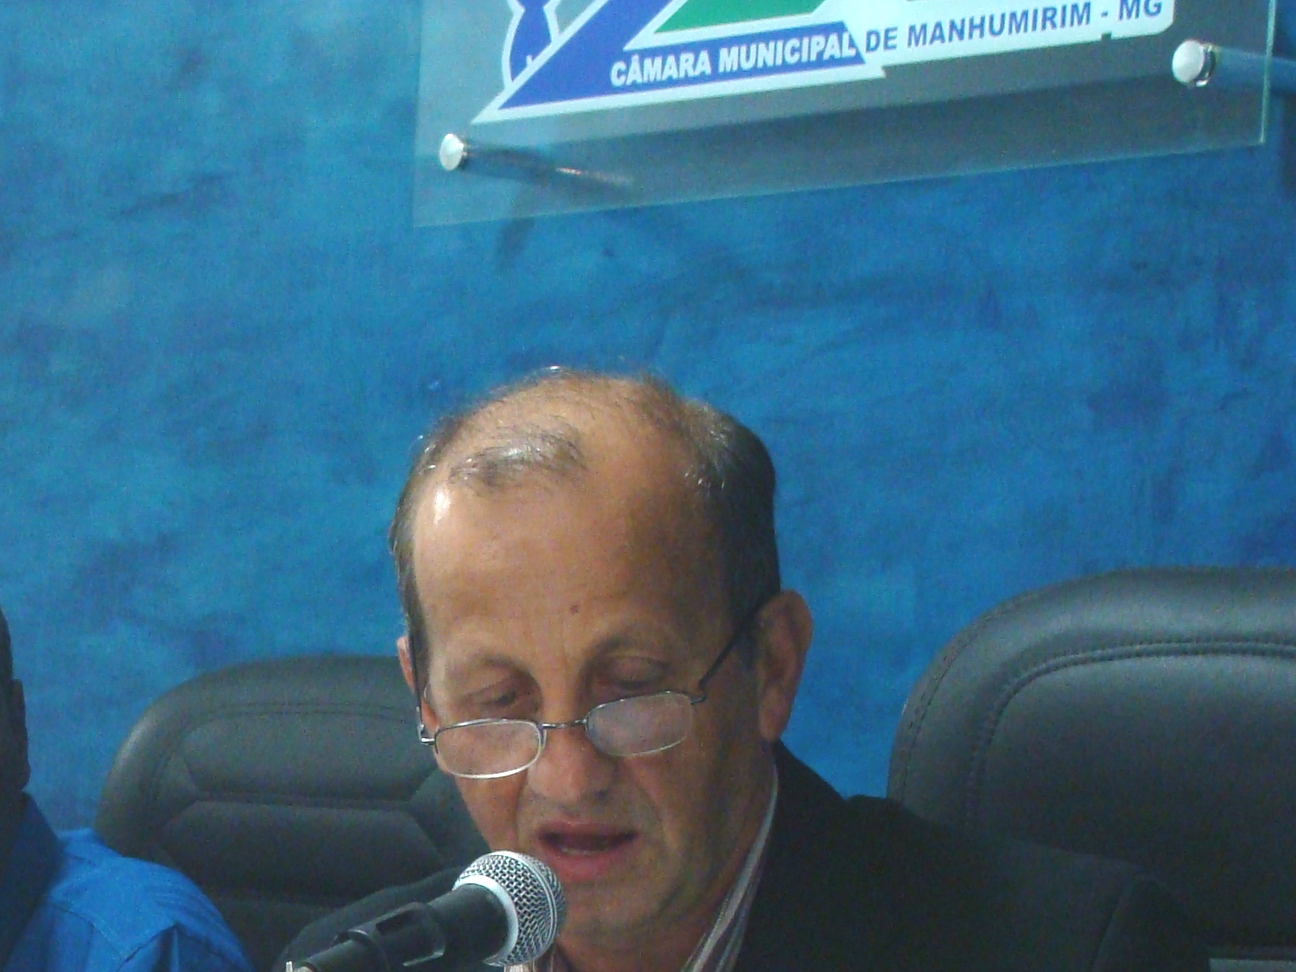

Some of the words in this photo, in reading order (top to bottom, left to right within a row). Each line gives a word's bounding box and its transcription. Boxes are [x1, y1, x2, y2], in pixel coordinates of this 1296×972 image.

[610, 51, 712, 87] CÂMARA
[718, 31, 856, 74] MUNICIPAL
[865, 26, 898, 53] DE
[907, 2, 1092, 48] MANHUMIRIM
[1118, 0, 1163, 21] MG
